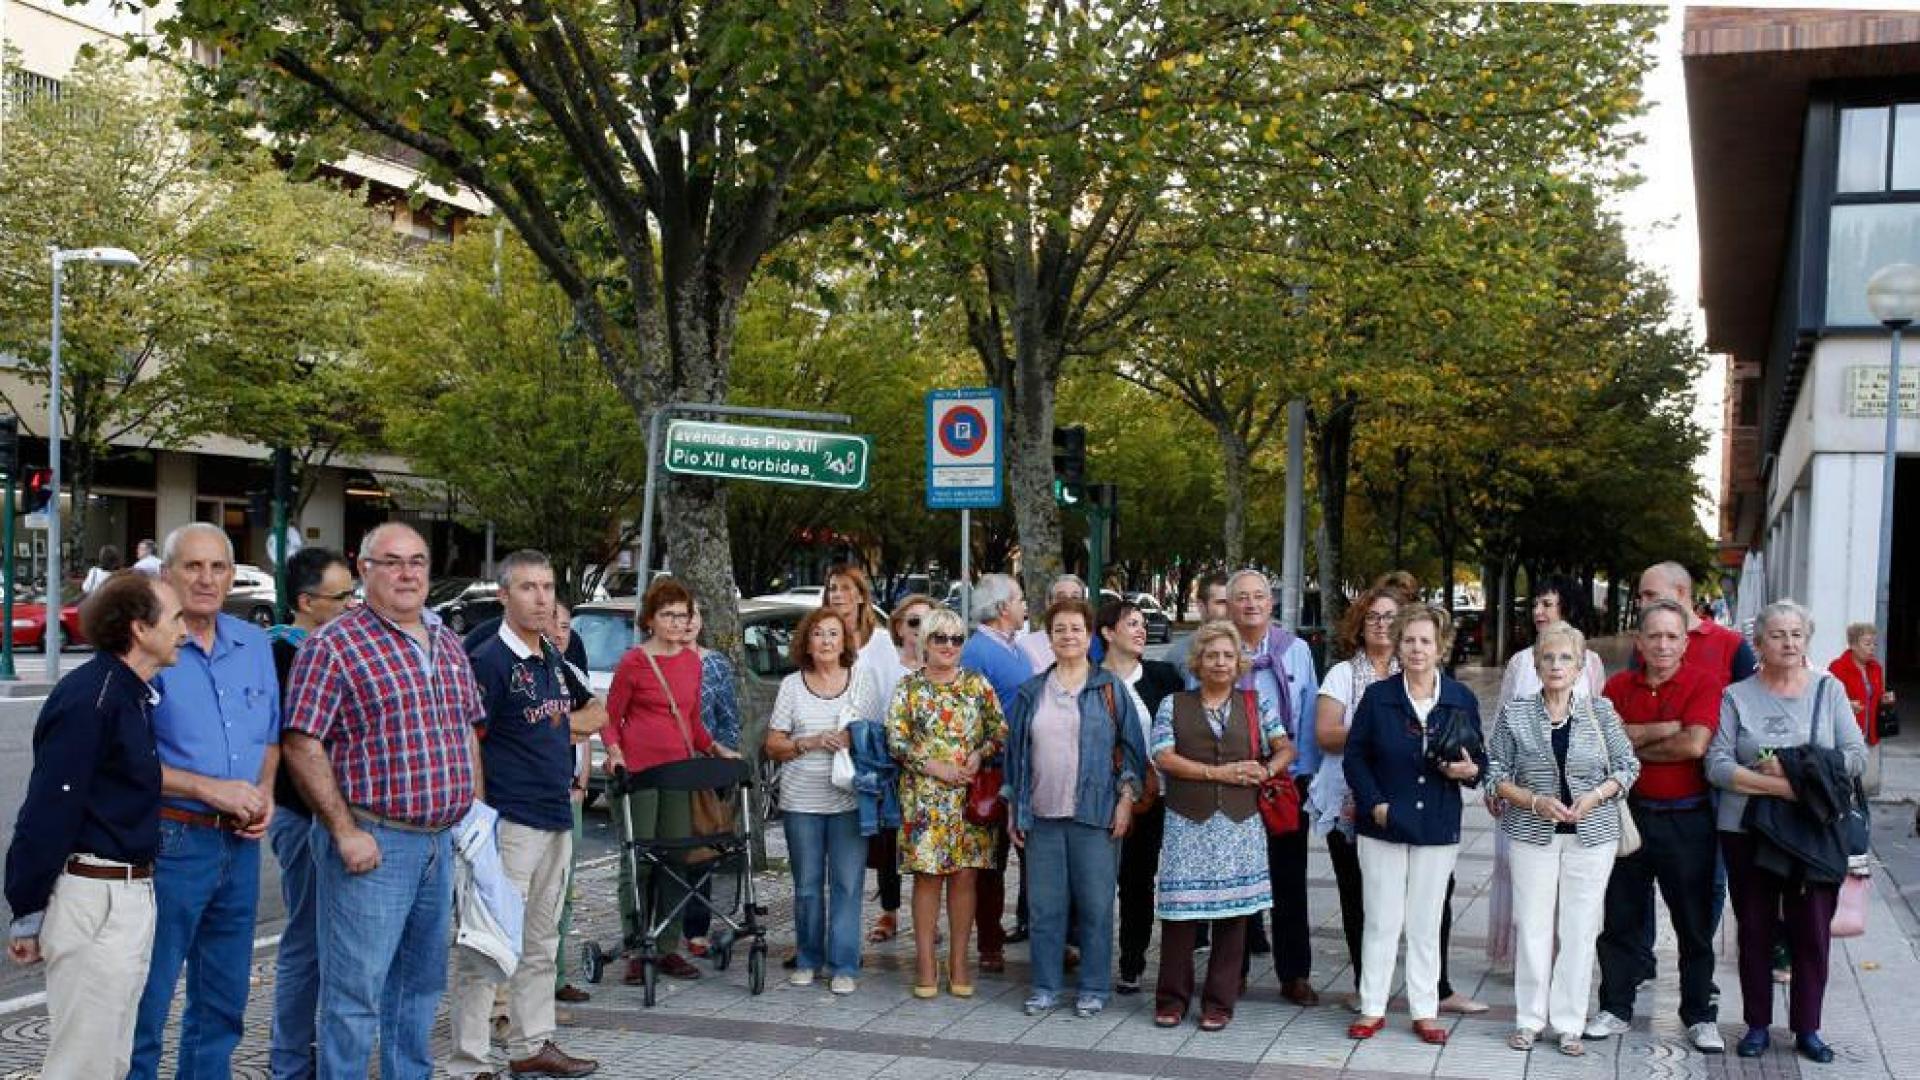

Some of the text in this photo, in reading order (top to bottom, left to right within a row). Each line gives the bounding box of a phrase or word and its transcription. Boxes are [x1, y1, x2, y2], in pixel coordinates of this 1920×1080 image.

[674, 429, 737, 447] avenida
[741, 433, 759, 449] de
[795, 437, 818, 454] XII
[702, 450, 725, 468] XII
